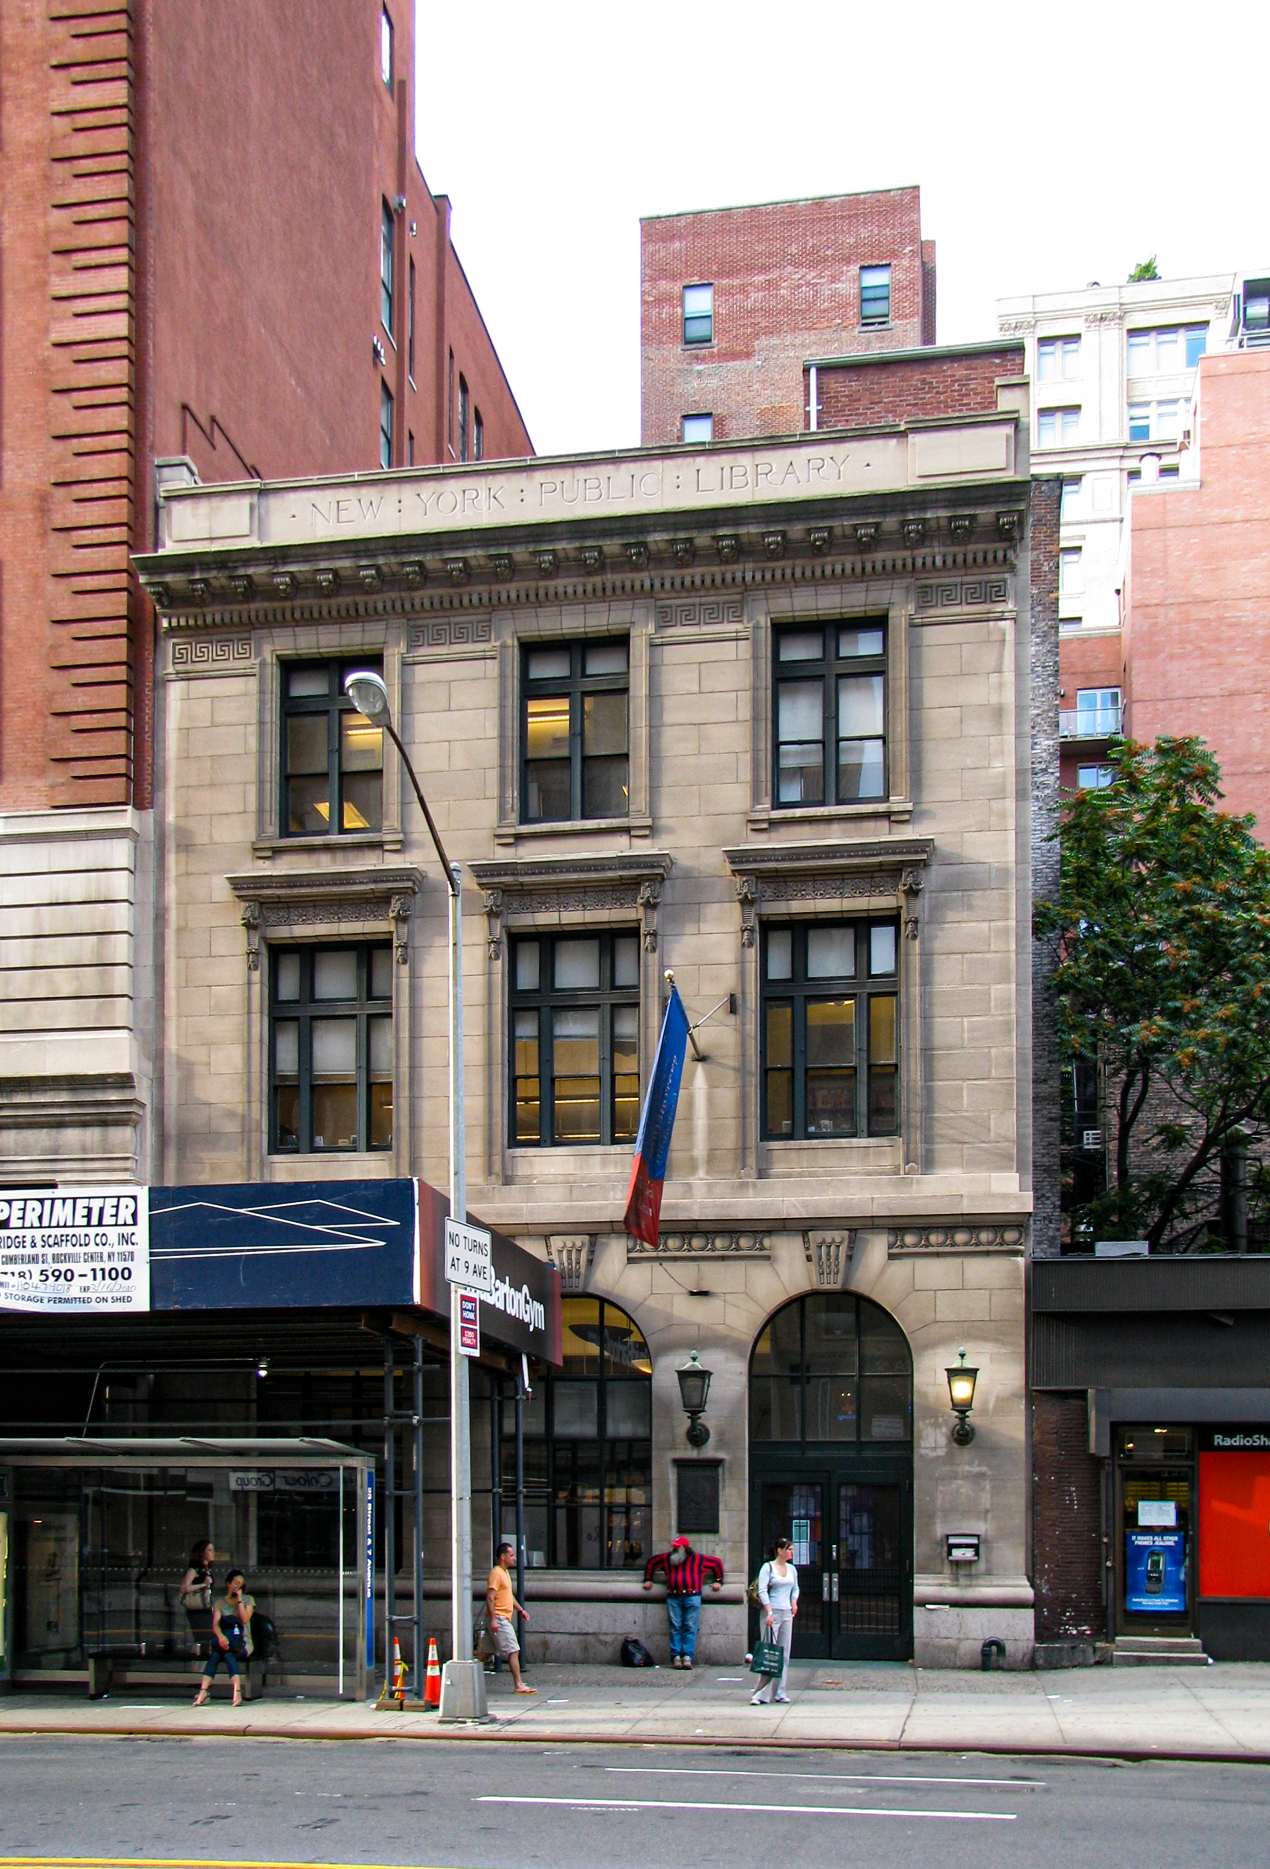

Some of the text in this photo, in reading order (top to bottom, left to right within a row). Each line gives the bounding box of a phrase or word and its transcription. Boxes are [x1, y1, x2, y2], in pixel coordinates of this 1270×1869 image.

[311, 454, 852, 528] NEW YORK PUBLIC LIBRARY
[30, 1235, 38, 1249] &
[41, 1232, 91, 1249] SCAFFOLD
[117, 1232, 139, 1247] INC.
[448, 1230, 489, 1257] NO TURNS
[52, 1252, 82, 1265] ROCKVILLE
[107, 1251, 116, 1263] NY
[117, 1251, 135, 1263] 11570
[450, 1257, 488, 1281] AT 9 AVE
[4, 1292, 133, 1305] STORAGE PERMITTED ON SHED
[1214, 1434, 1270, 1446] RadioSh
